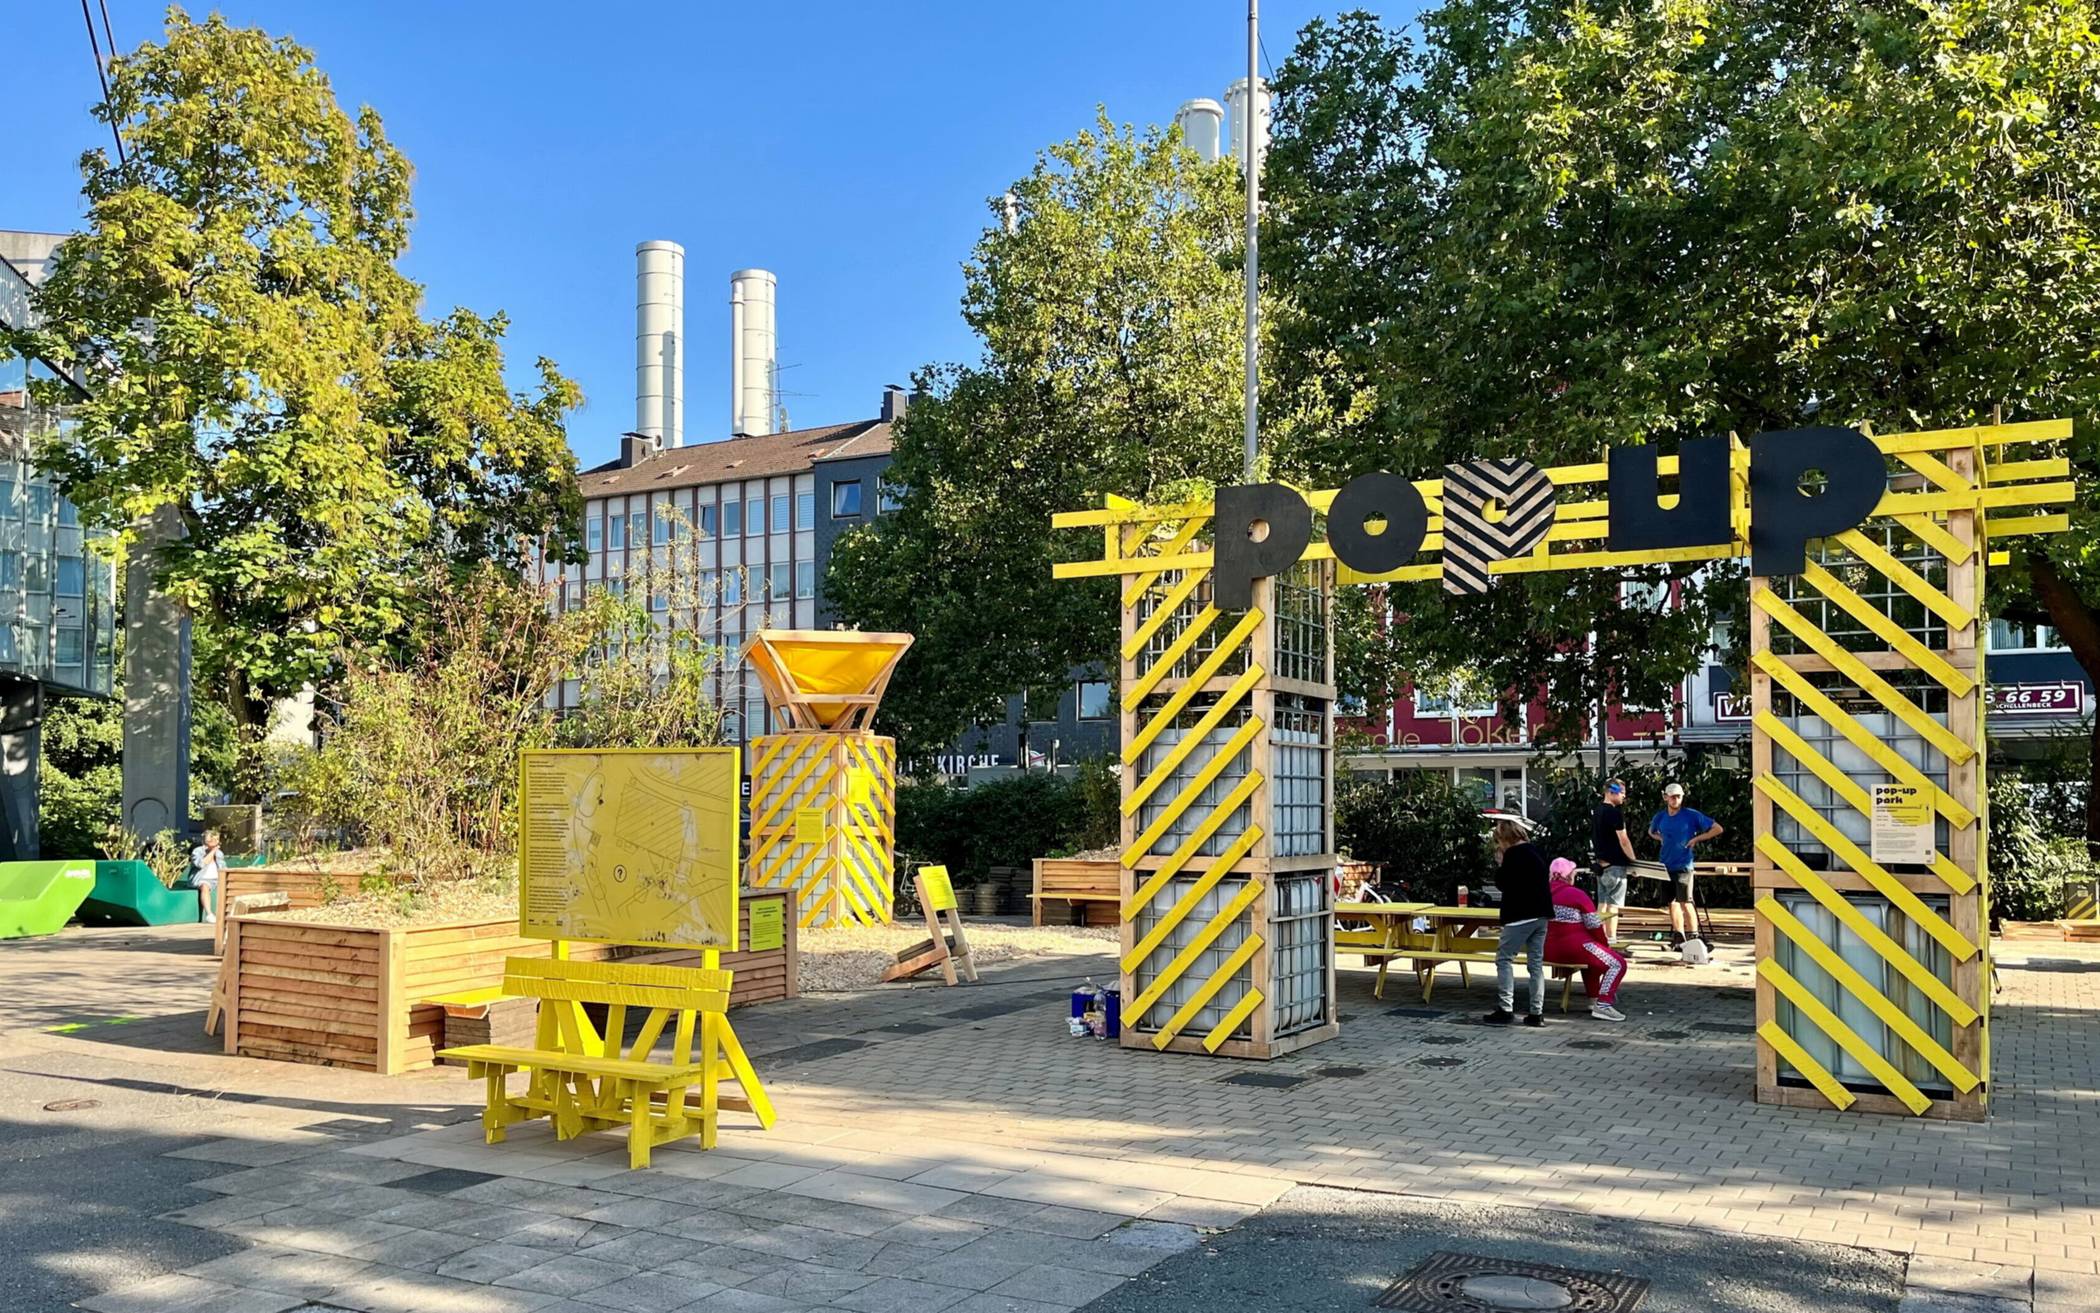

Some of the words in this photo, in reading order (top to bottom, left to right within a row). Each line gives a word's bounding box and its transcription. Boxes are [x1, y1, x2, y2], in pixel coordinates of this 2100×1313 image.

[2005, 691, 2032, 703] 66
[2040, 690, 2066, 702] 59
[1876, 787, 1917, 796] pop-up
[1876, 796, 1903, 805] park
